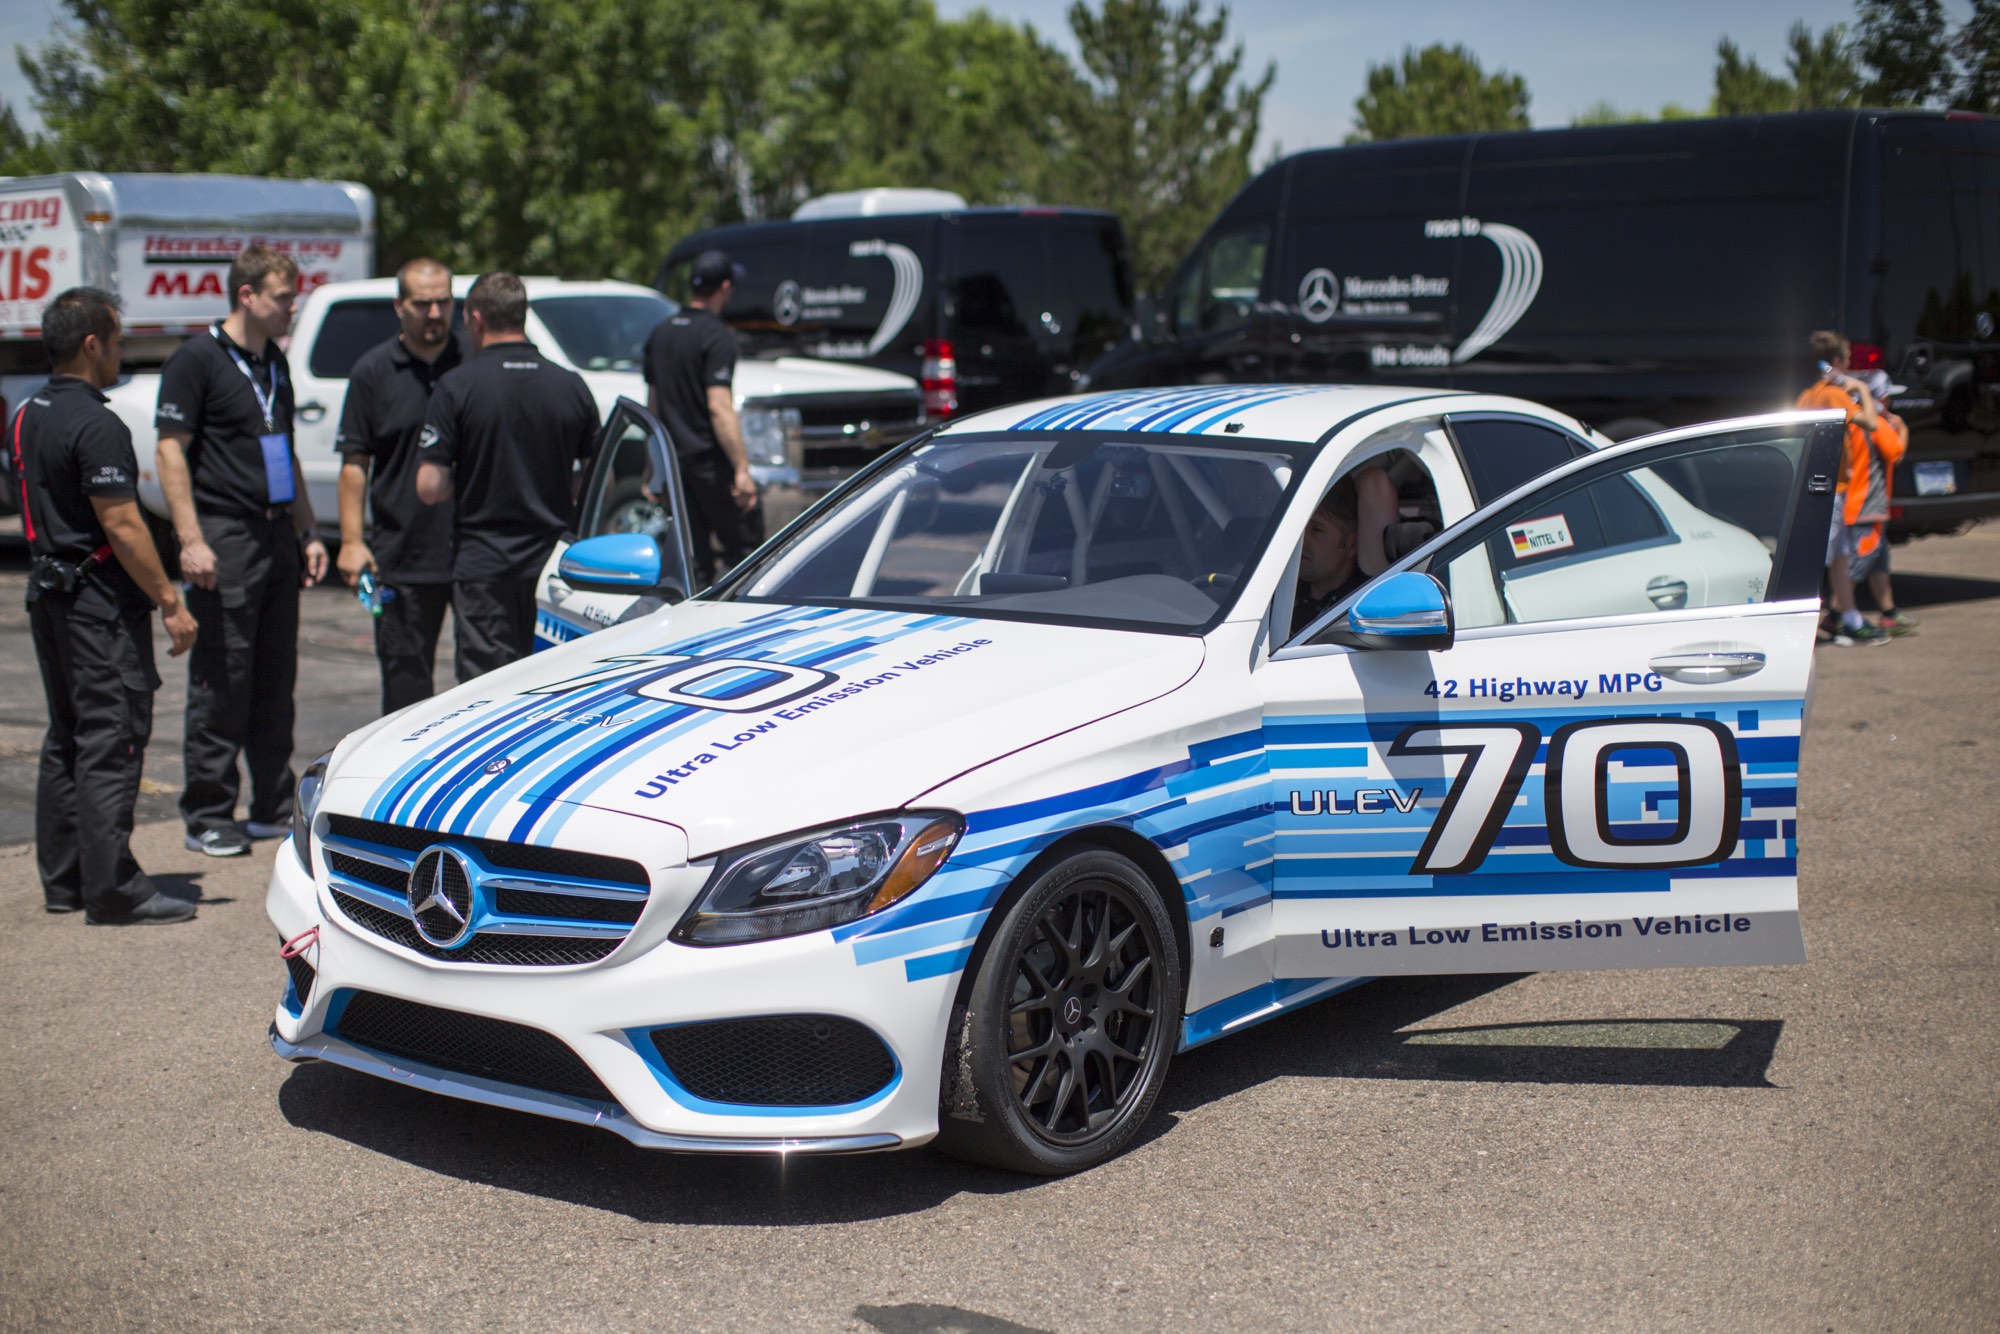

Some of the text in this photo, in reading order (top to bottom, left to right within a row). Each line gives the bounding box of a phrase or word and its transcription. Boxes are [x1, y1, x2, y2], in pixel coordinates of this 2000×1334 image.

[1425, 215, 1480, 238] race to
[144, 235, 242, 257] Honda
[1343, 274, 1450, 299] Mercedes-Benz
[1372, 343, 1450, 366] the clouds
[1529, 533, 1556, 548] NITTEL
[516, 653, 841, 715] 70
[1424, 672, 1663, 703] 42 Highway MPG
[524, 708, 634, 729] ULEV
[634, 637, 994, 800] Ultra Low Emission Vehicle
[1290, 787, 1424, 816] ULEV
[1386, 717, 1743, 876] 70
[1321, 913, 1751, 948] Ultra Low Emission Vehicle
